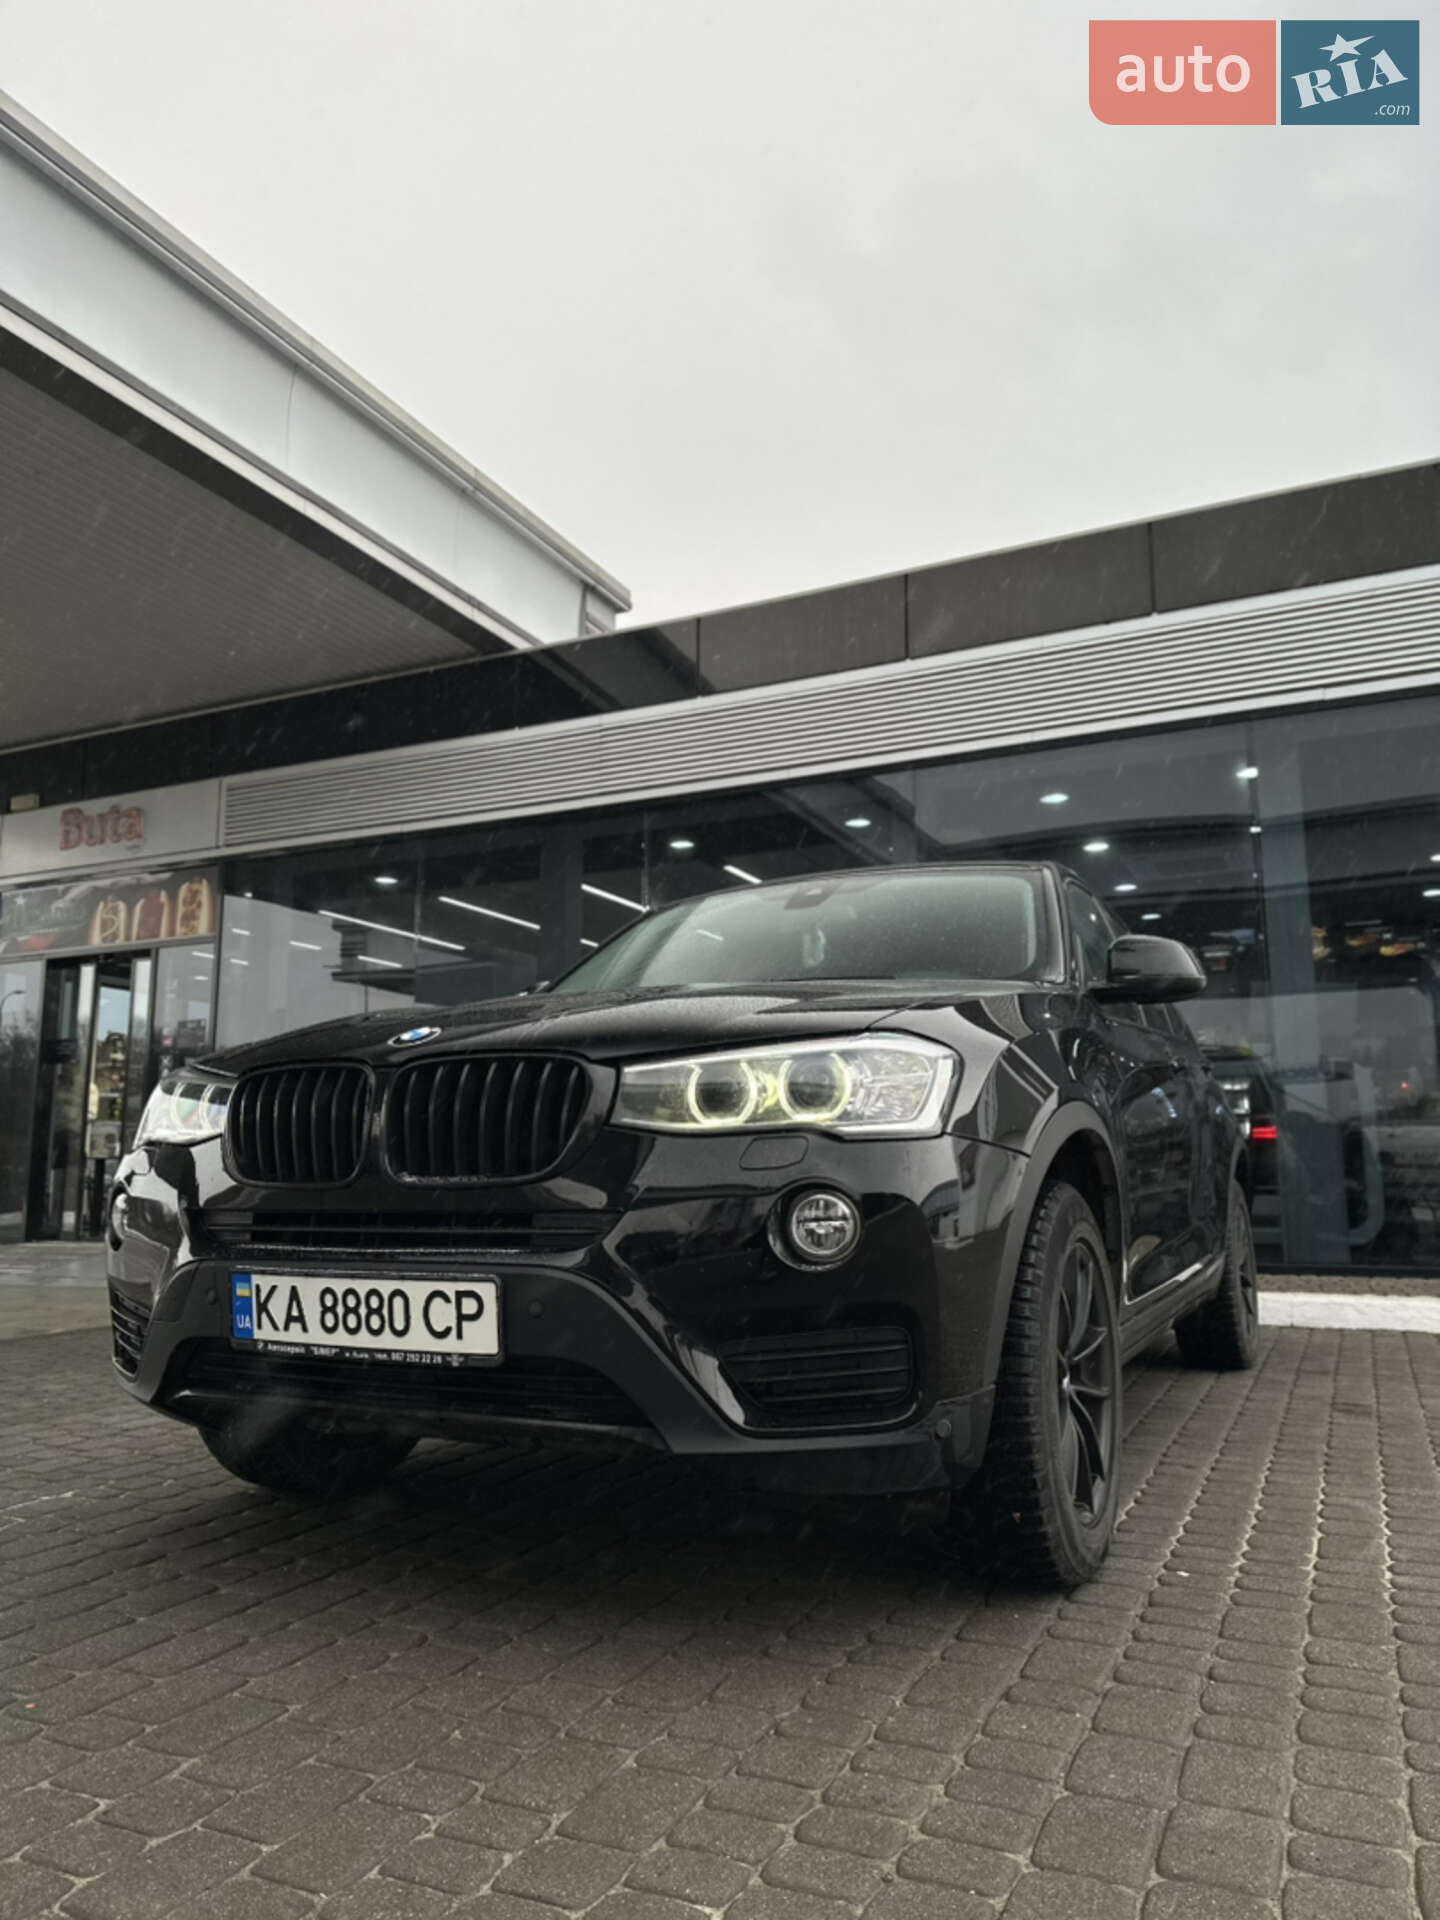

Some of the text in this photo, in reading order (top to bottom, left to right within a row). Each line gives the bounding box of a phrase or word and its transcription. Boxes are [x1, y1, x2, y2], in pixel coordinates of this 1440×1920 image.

[236, 1314, 251, 1329] UA
[255, 1283, 485, 1340] KA 8880 CP
